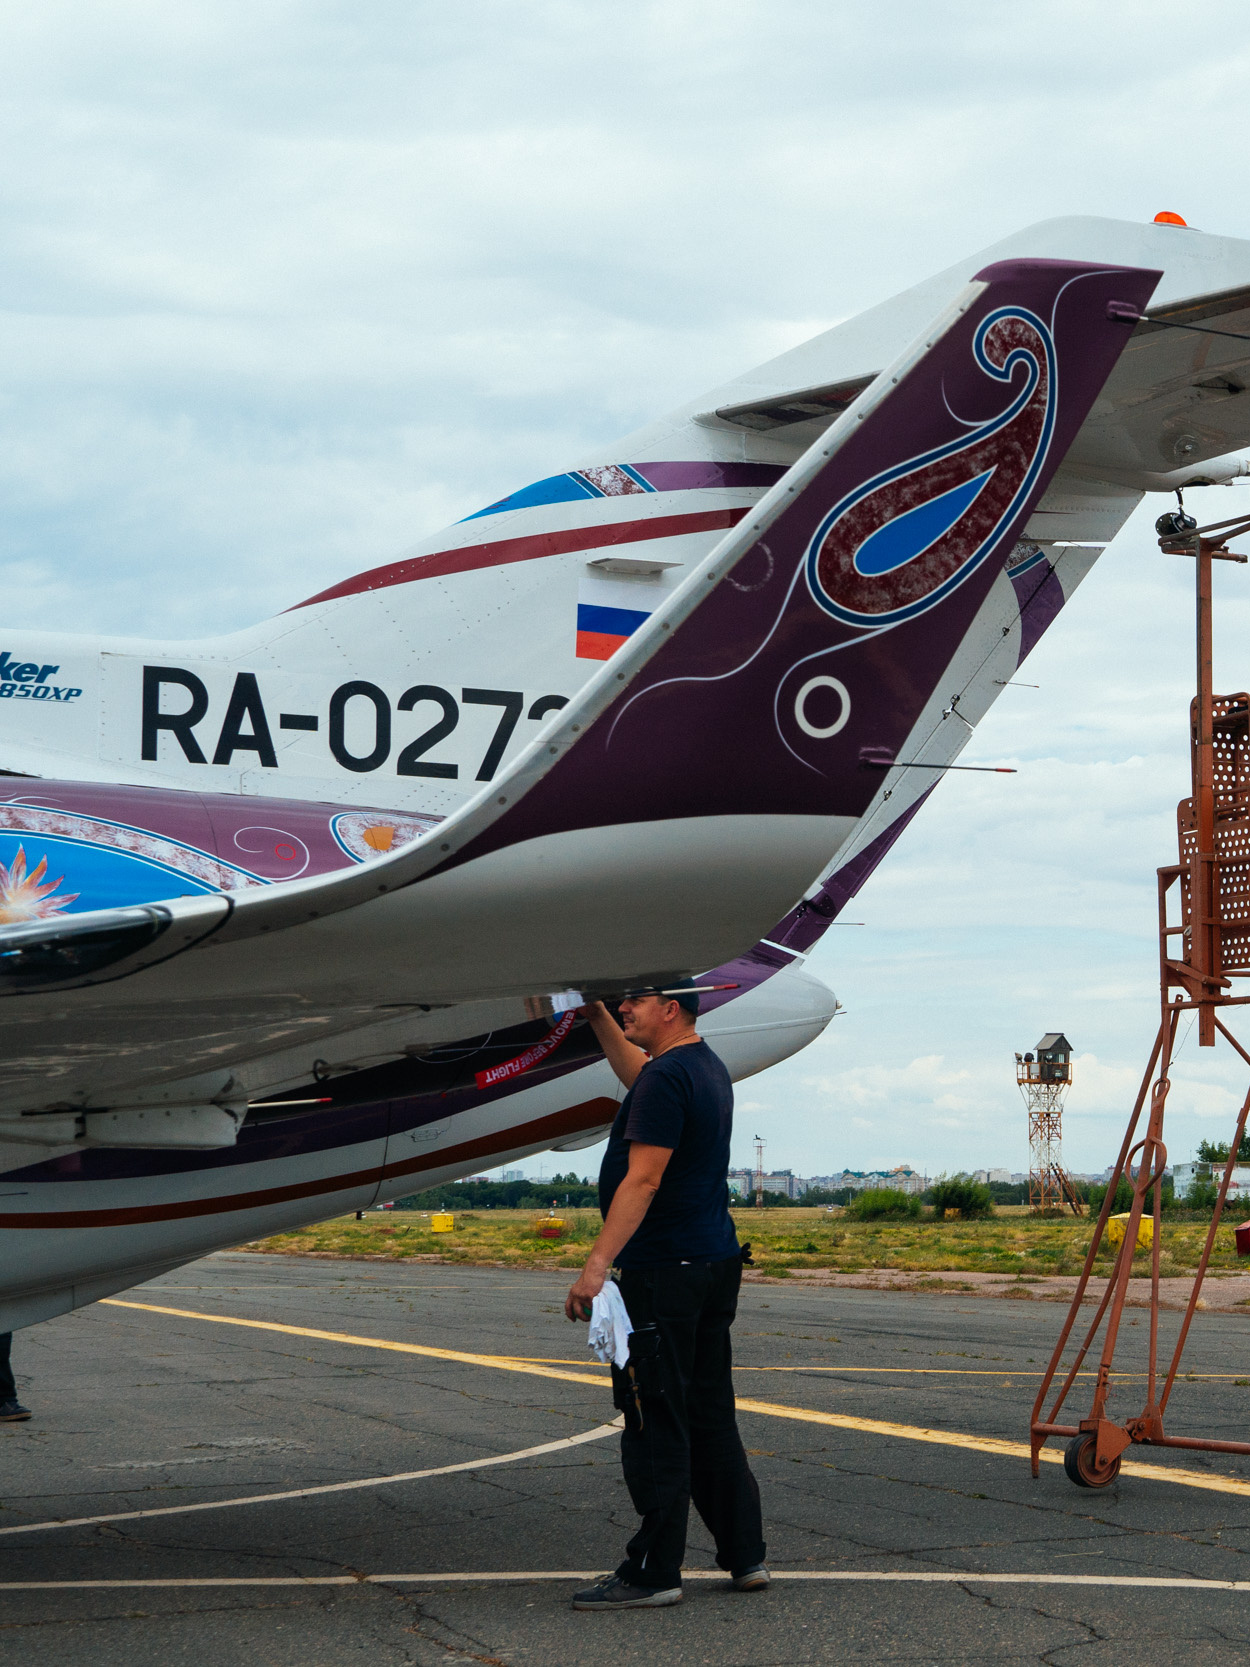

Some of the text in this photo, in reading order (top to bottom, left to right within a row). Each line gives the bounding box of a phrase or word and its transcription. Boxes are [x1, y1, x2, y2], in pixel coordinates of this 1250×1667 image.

[0, 683, 83, 701] 850XP
[485, 1009, 577, 1083] EMOVE BEFORE FLIGHT
